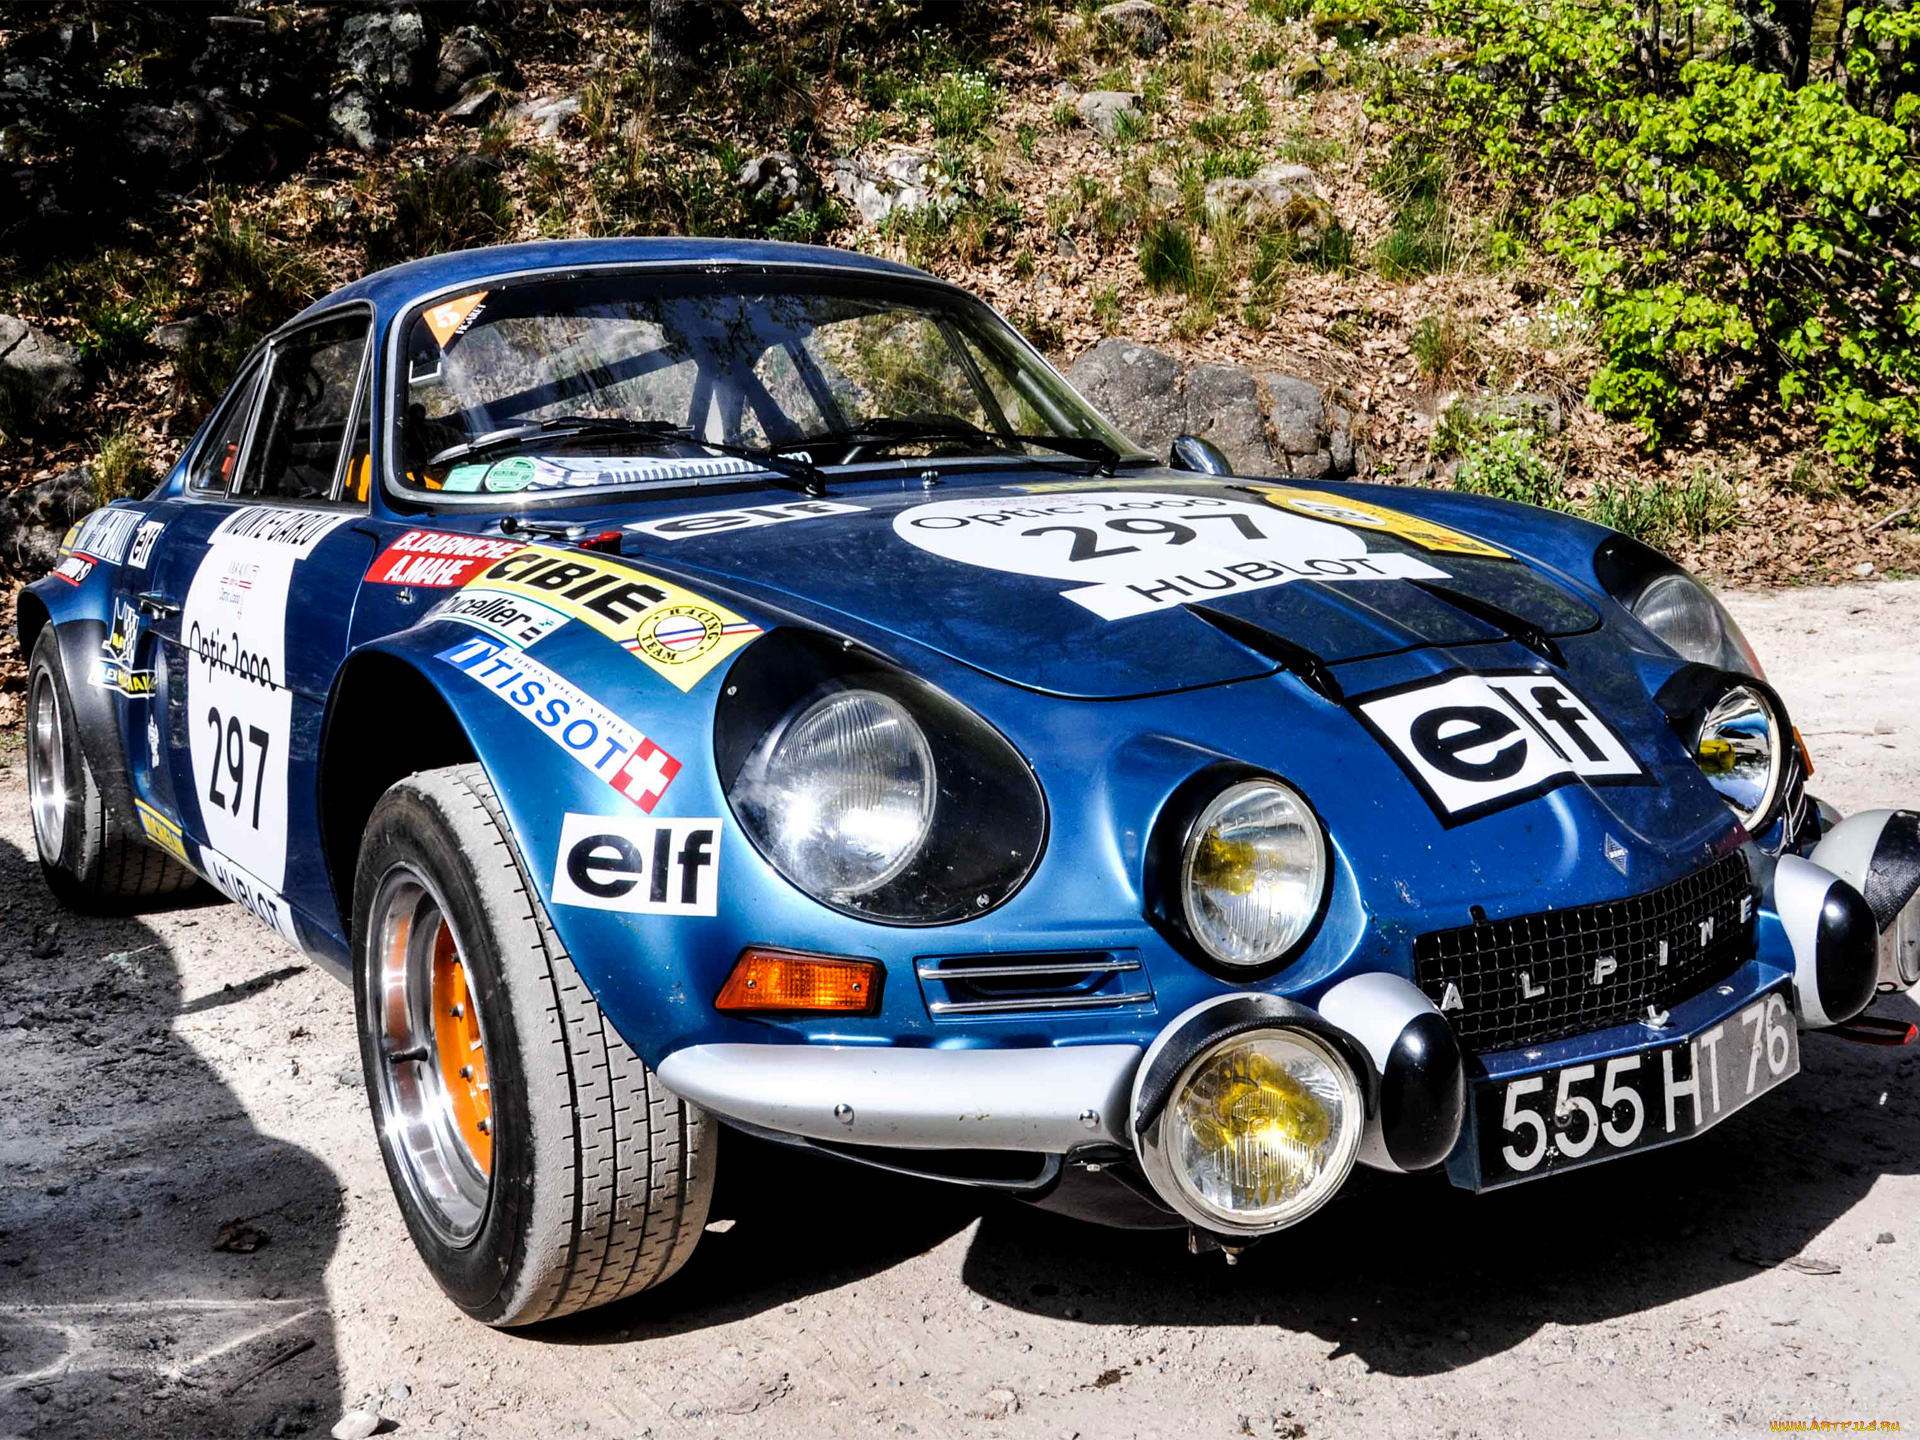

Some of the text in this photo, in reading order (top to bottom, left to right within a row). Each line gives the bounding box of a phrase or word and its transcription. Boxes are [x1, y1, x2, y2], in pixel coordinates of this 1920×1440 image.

[433, 303, 460, 328] 5
[222, 507, 340, 546] MONTE-CARLO
[654, 503, 836, 532] elf
[1020, 513, 1269, 563] 297
[132, 527, 161, 564] elf
[1126, 557, 1387, 603] HUBLOT
[642, 634, 677, 661] TEAM
[669, 607, 720, 641] RACING
[480, 657, 629, 770] TISSOT
[1410, 686, 1609, 783] elf
[208, 706, 269, 831] 297
[566, 828, 714, 905] elf
[212, 861, 286, 937] HUBLOT
[1440, 898, 1754, 1012] ALPINE
[1502, 993, 1791, 1172] 555 HT 76
